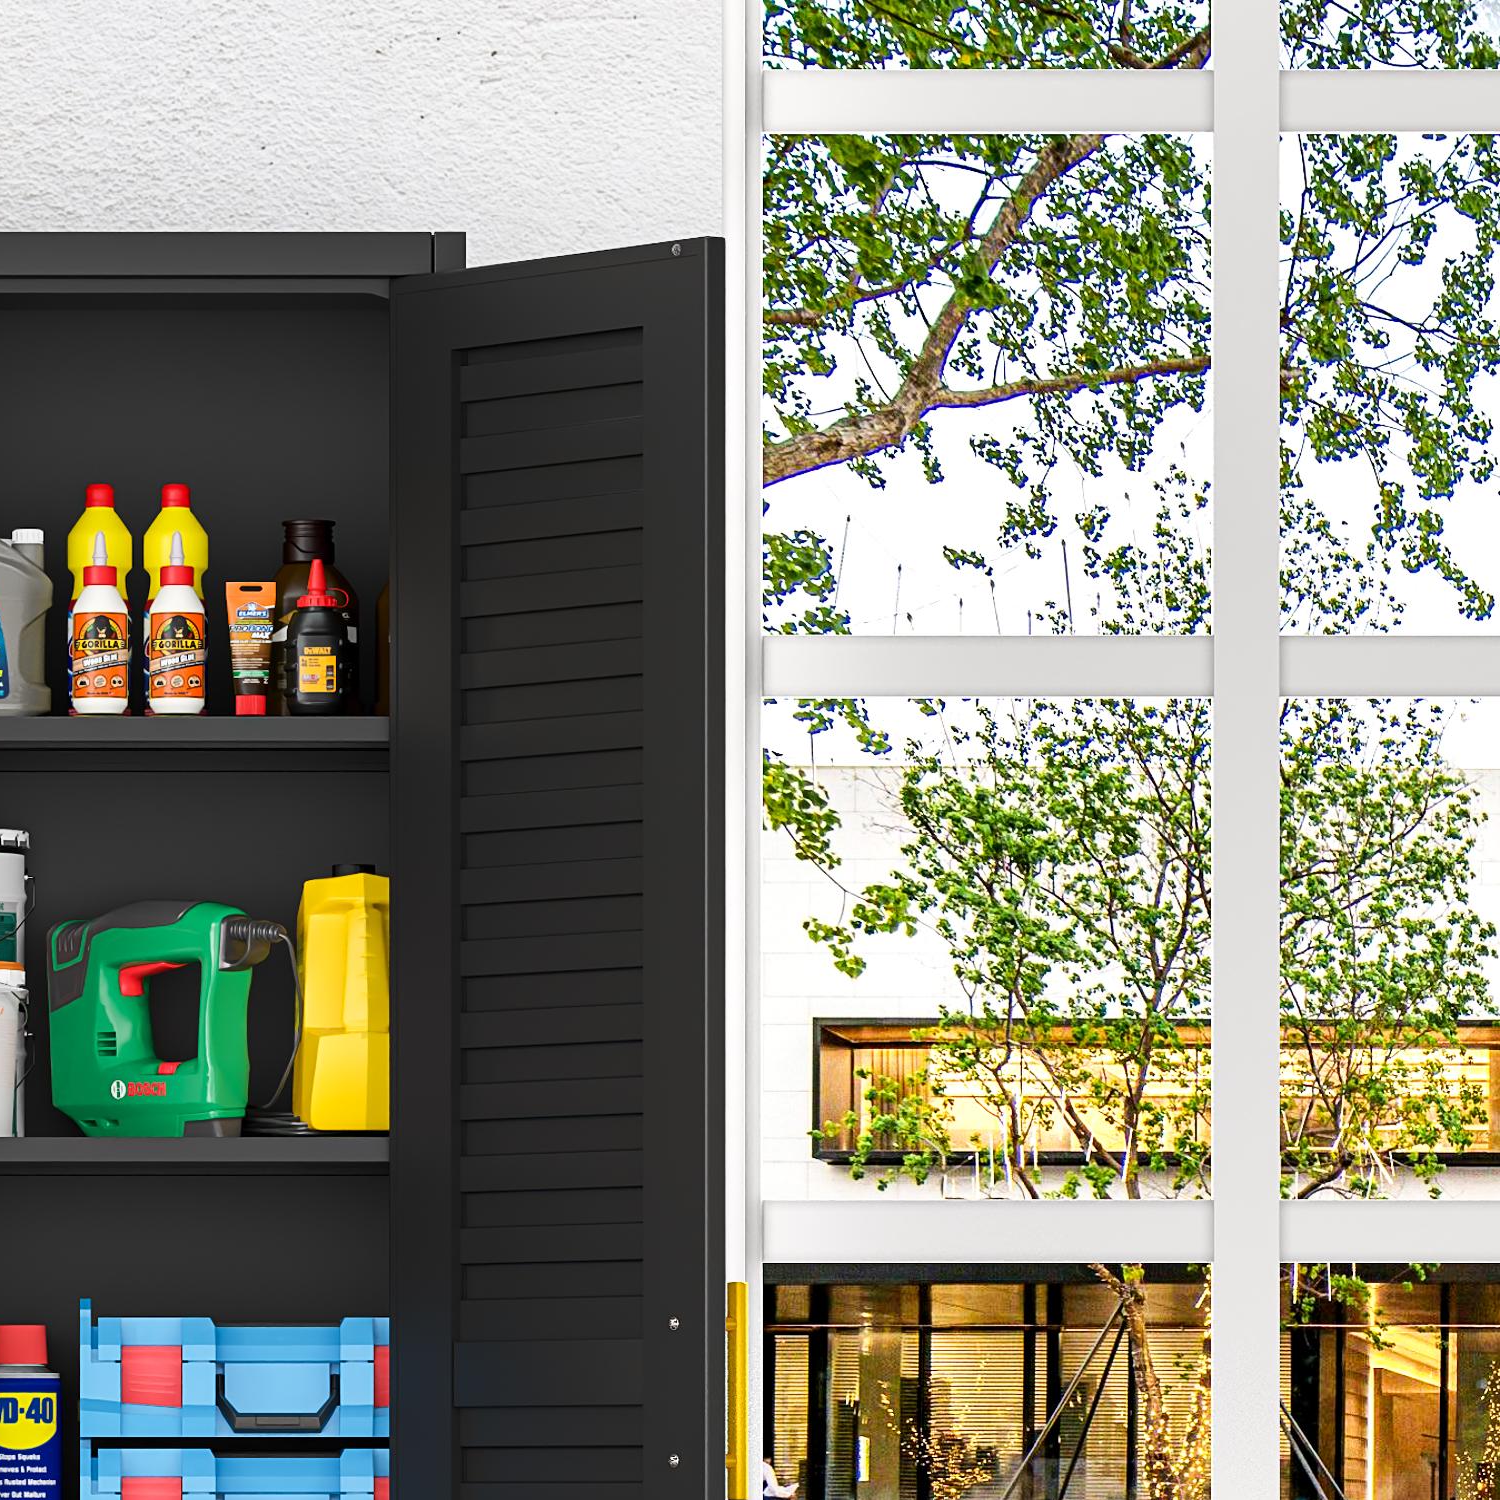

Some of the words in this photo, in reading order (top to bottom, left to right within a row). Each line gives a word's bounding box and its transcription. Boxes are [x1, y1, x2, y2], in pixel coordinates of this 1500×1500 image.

[81, 640, 119, 648] GORILLA
[158, 640, 197, 648] GORILLA
[128, 1082, 166, 1097] BOSCH
